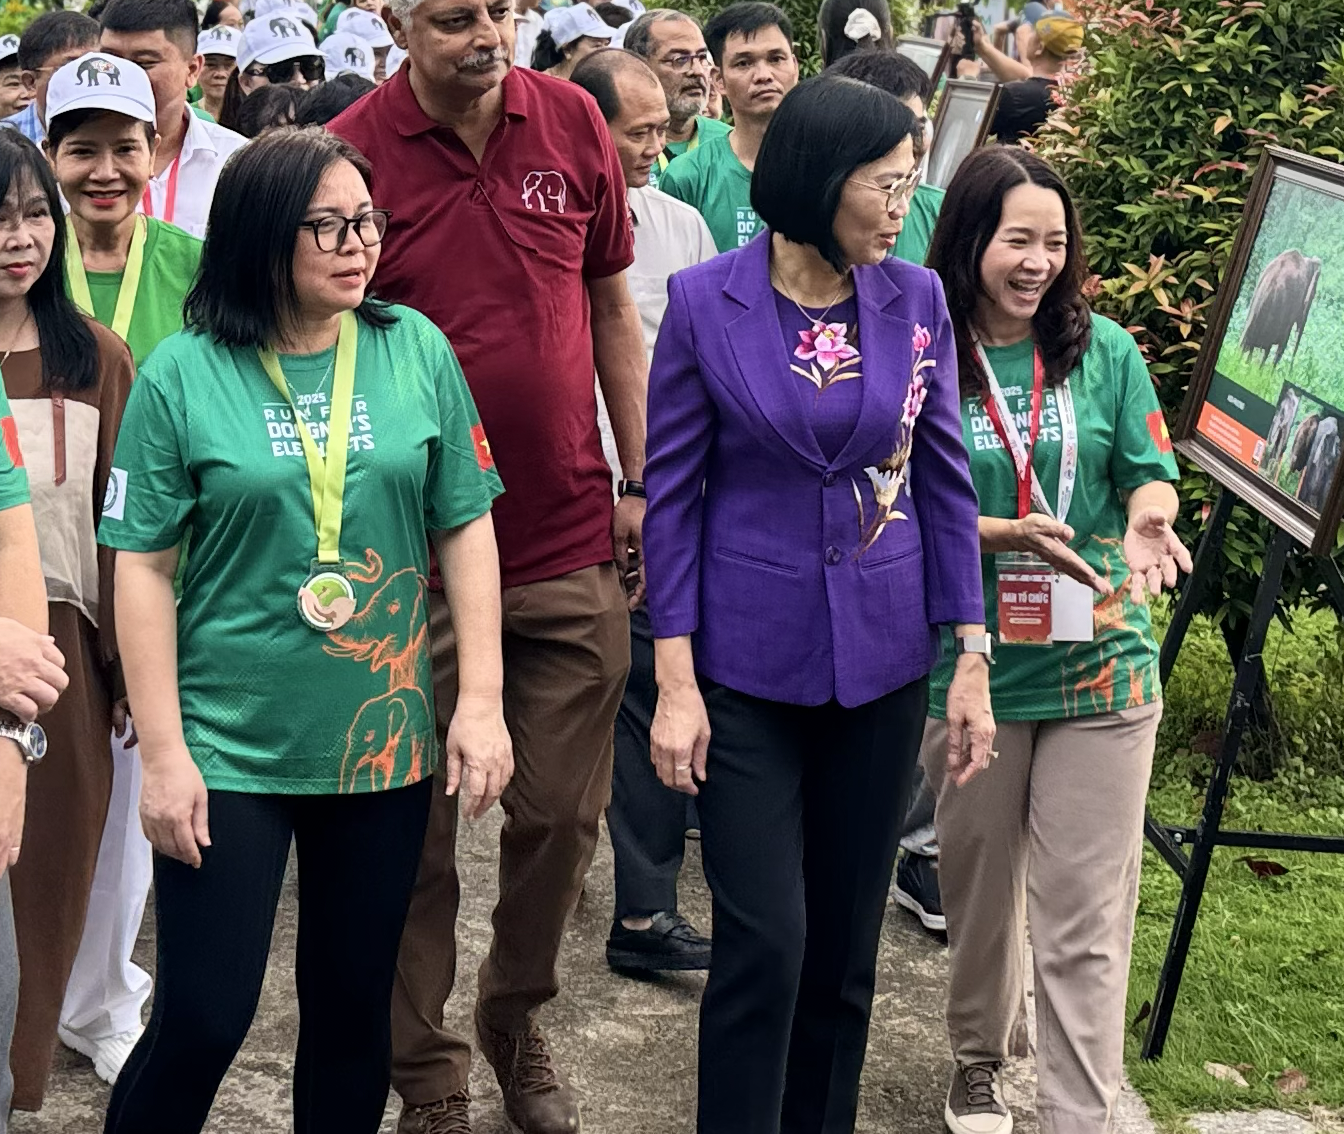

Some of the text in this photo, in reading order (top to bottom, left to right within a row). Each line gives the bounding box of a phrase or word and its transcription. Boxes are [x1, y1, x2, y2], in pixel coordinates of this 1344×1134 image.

[296, 392, 327, 406] 2025
[1017, 394, 1056, 411] FR
[320, 400, 368, 419] FR
